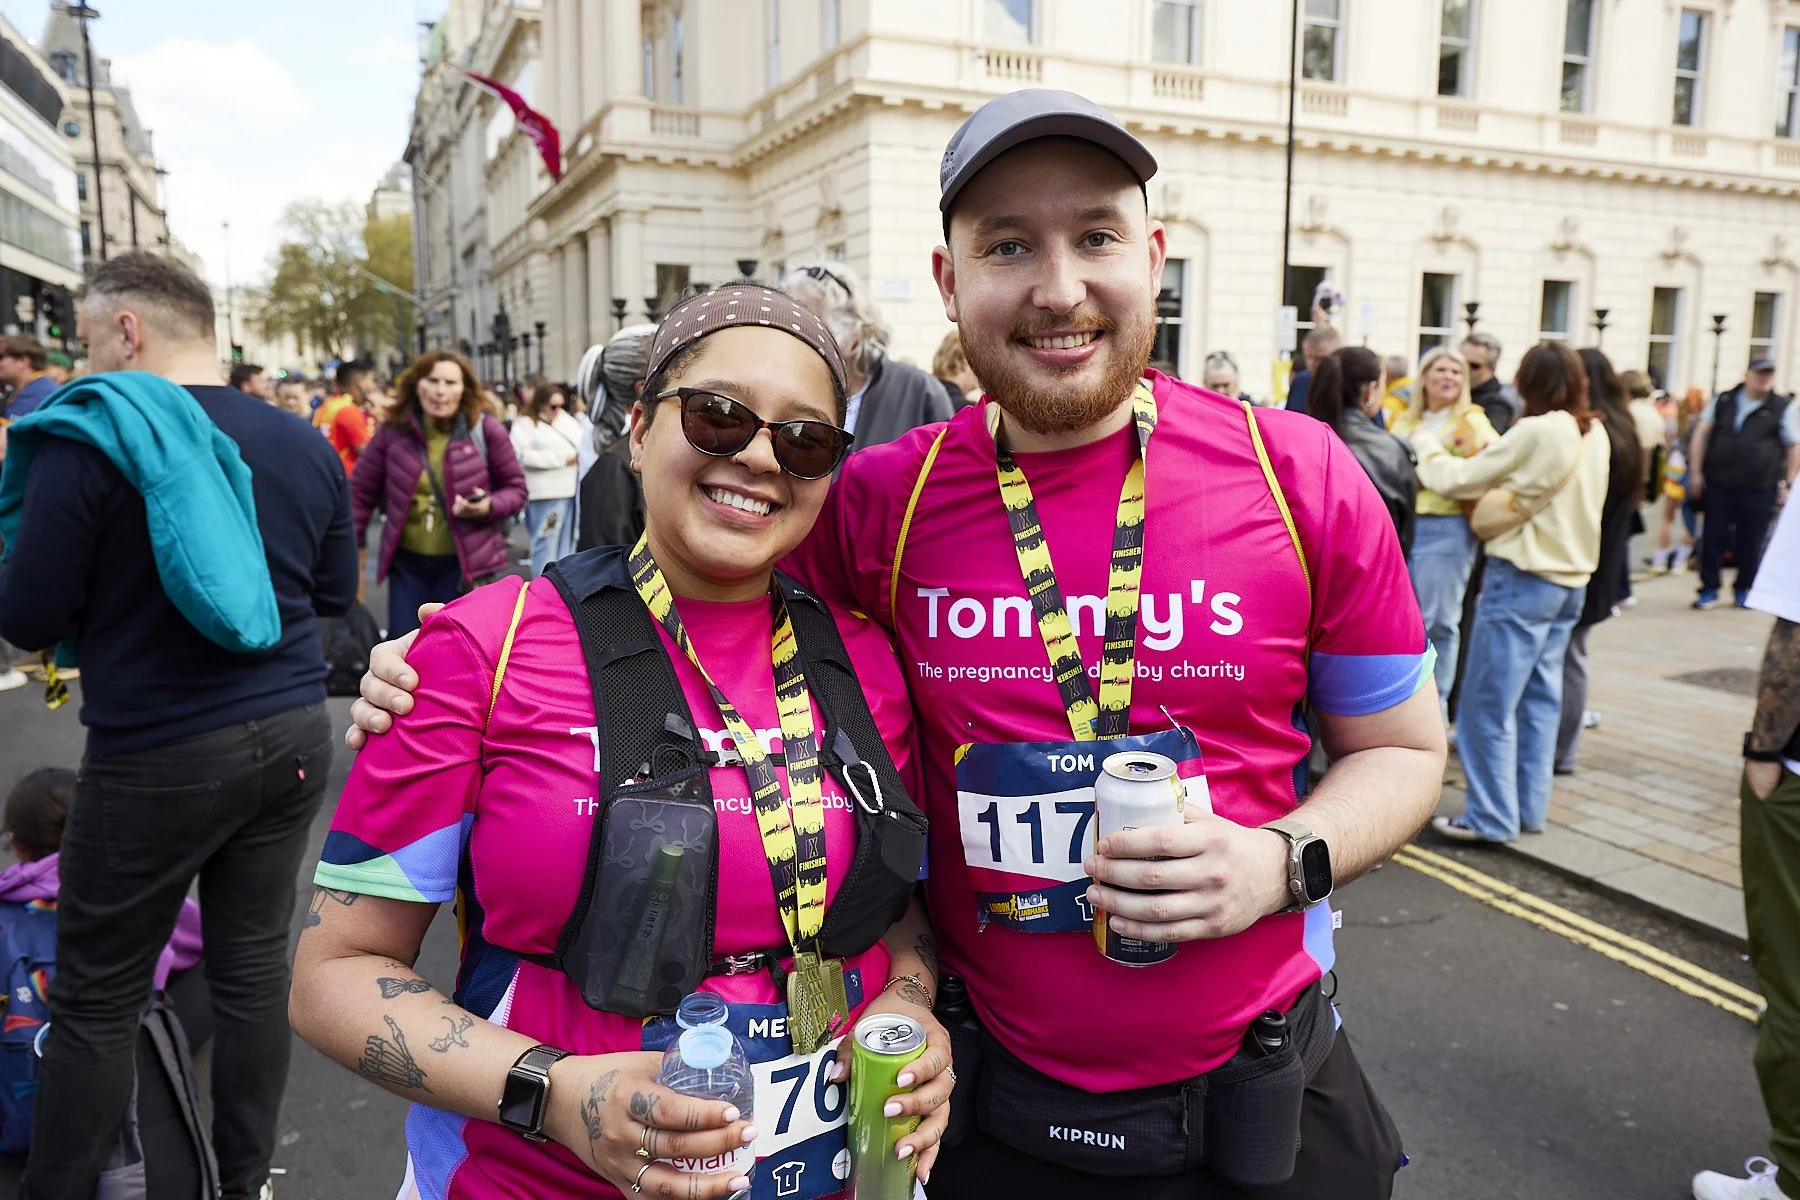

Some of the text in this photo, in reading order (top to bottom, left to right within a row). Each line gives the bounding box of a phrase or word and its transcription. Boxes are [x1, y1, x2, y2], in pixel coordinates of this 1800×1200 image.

[1014, 524, 1041, 542] FINISHER
[1112, 546, 1142, 559] FINISHER
[1104, 639, 1133, 651] FINISHER
[917, 661, 943, 678] The
[948, 664, 1054, 683] pregnancy
[1170, 659, 1245, 681] charity
[777, 673, 805, 692] FINISHER
[790, 757, 819, 771] FINISHER
[1047, 753, 1095, 773] TOM
[754, 780, 781, 801] FINISHER
[977, 801, 1096, 864] 117
[799, 856, 826, 872] FINISHER
[1049, 1125, 1126, 1151] KIPRUN
[672, 1149, 735, 1171] evian
